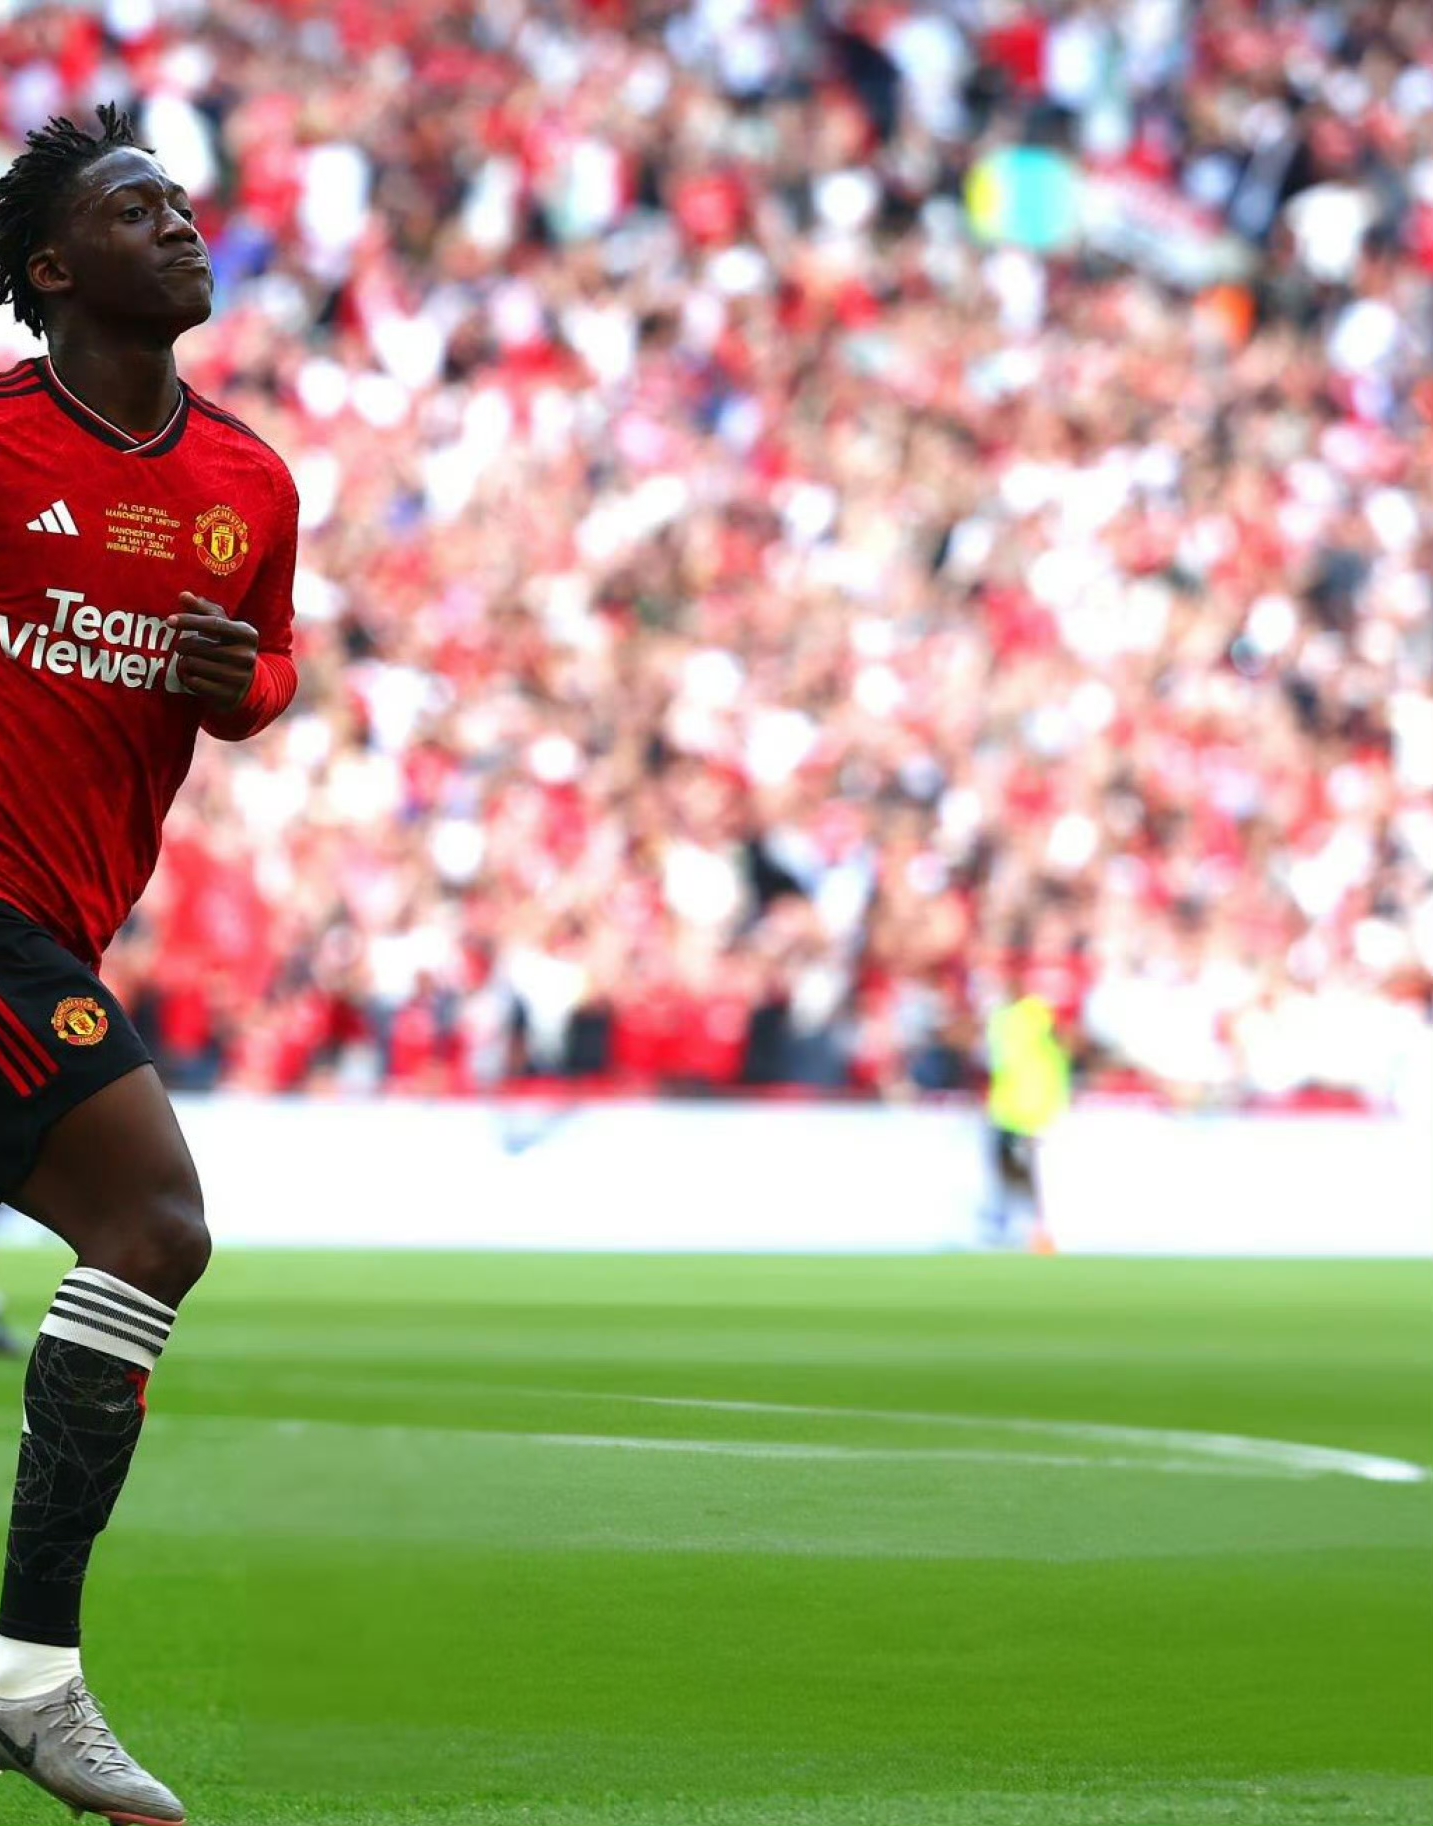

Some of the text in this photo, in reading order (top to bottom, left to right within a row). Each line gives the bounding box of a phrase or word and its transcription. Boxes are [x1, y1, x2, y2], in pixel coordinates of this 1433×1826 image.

[106, 508, 181, 529] MANCHESTER UNITED
[118, 502, 169, 517] FA CUP FINAL
[198, 510, 244, 536] MANCHESTER
[108, 525, 175, 544] MANCHESTER CITY
[130, 536, 146, 547] MAY
[148, 540, 164, 550] 2024
[107, 542, 175, 560] WEMBLEY STADIUM
[46, 588, 176, 651] Team
